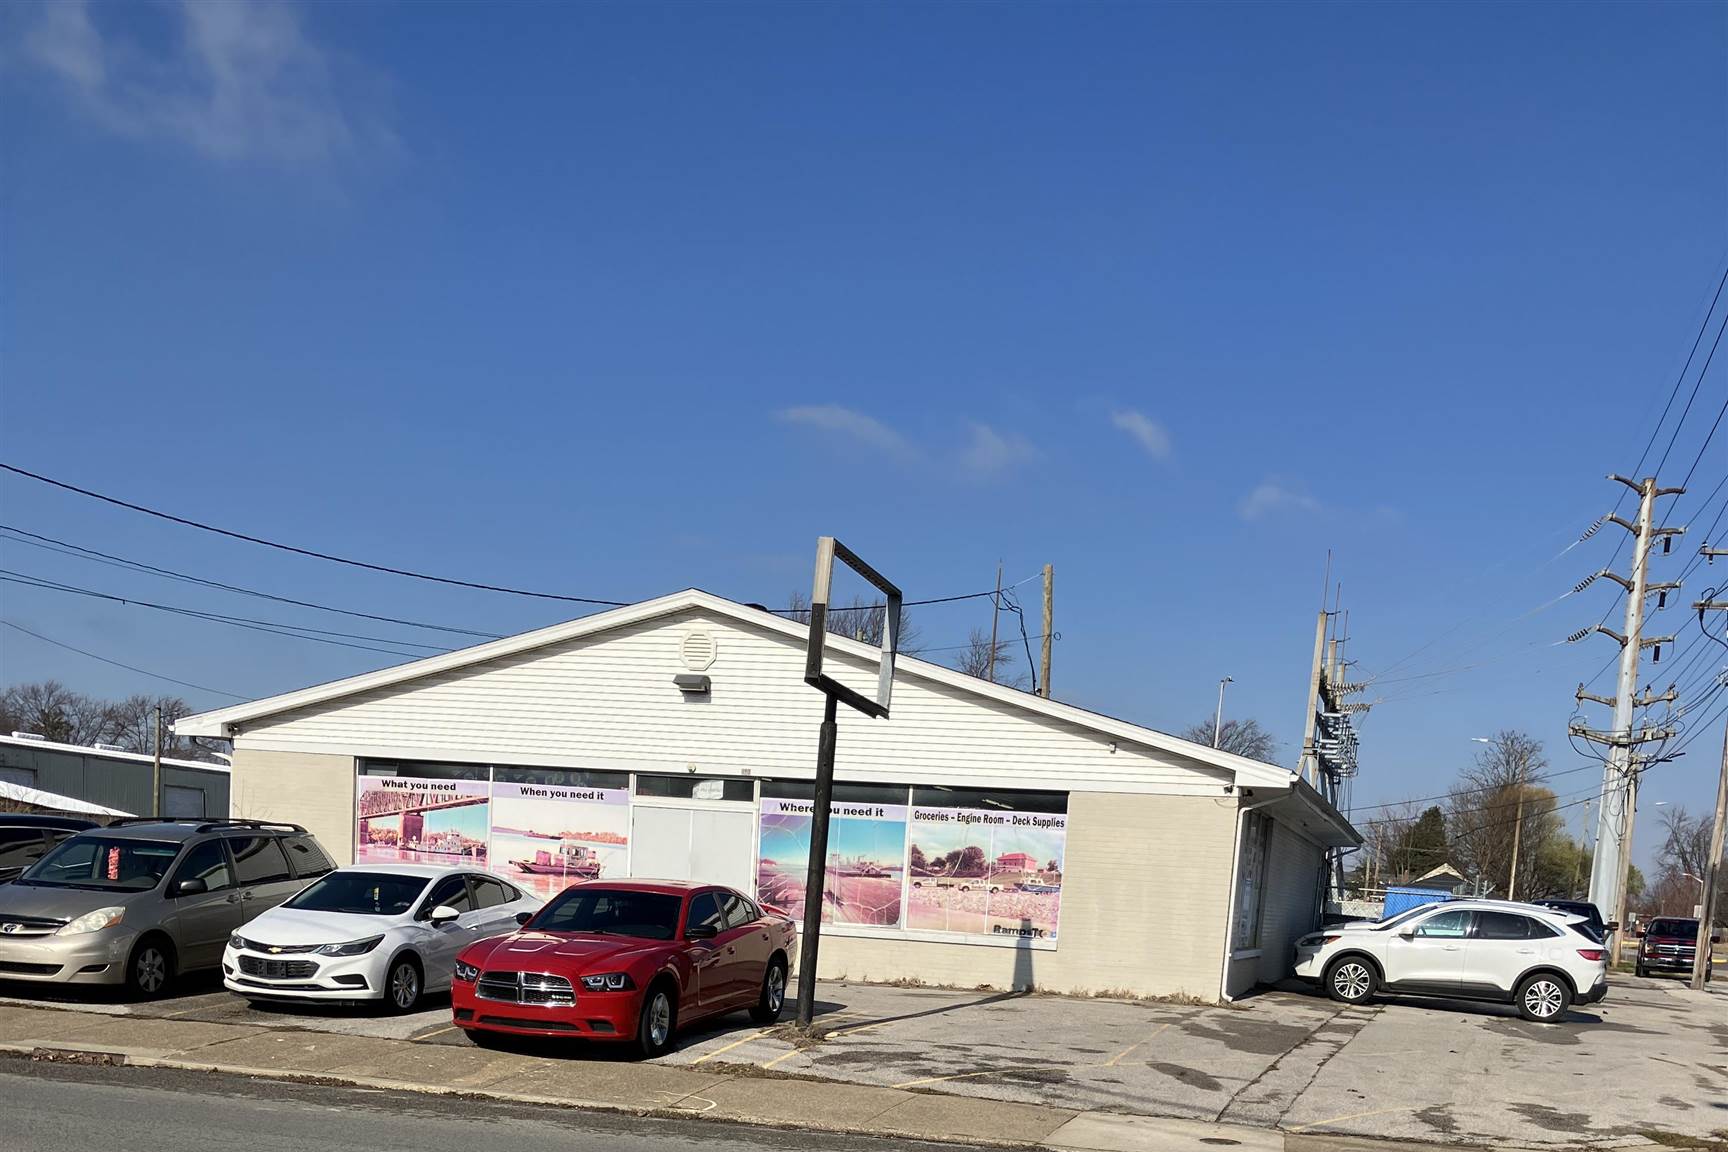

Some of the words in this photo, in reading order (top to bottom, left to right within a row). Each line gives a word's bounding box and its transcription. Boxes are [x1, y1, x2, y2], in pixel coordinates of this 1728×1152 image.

[381, 779, 408, 788] What
[430, 783, 456, 791] need
[520, 787, 548, 796] When
[550, 790, 568, 798] you
[570, 791, 594, 799] need
[597, 791, 604, 800] it
[780, 802, 814, 812] Where
[843, 807, 872, 816] need
[876, 808, 884, 816] it
[914, 810, 949, 821] Groceries
[957, 812, 982, 824] Engine
[983, 814, 1005, 824] Room
[1012, 815, 1031, 825] Deck
[1032, 816, 1065, 828] Supplies
